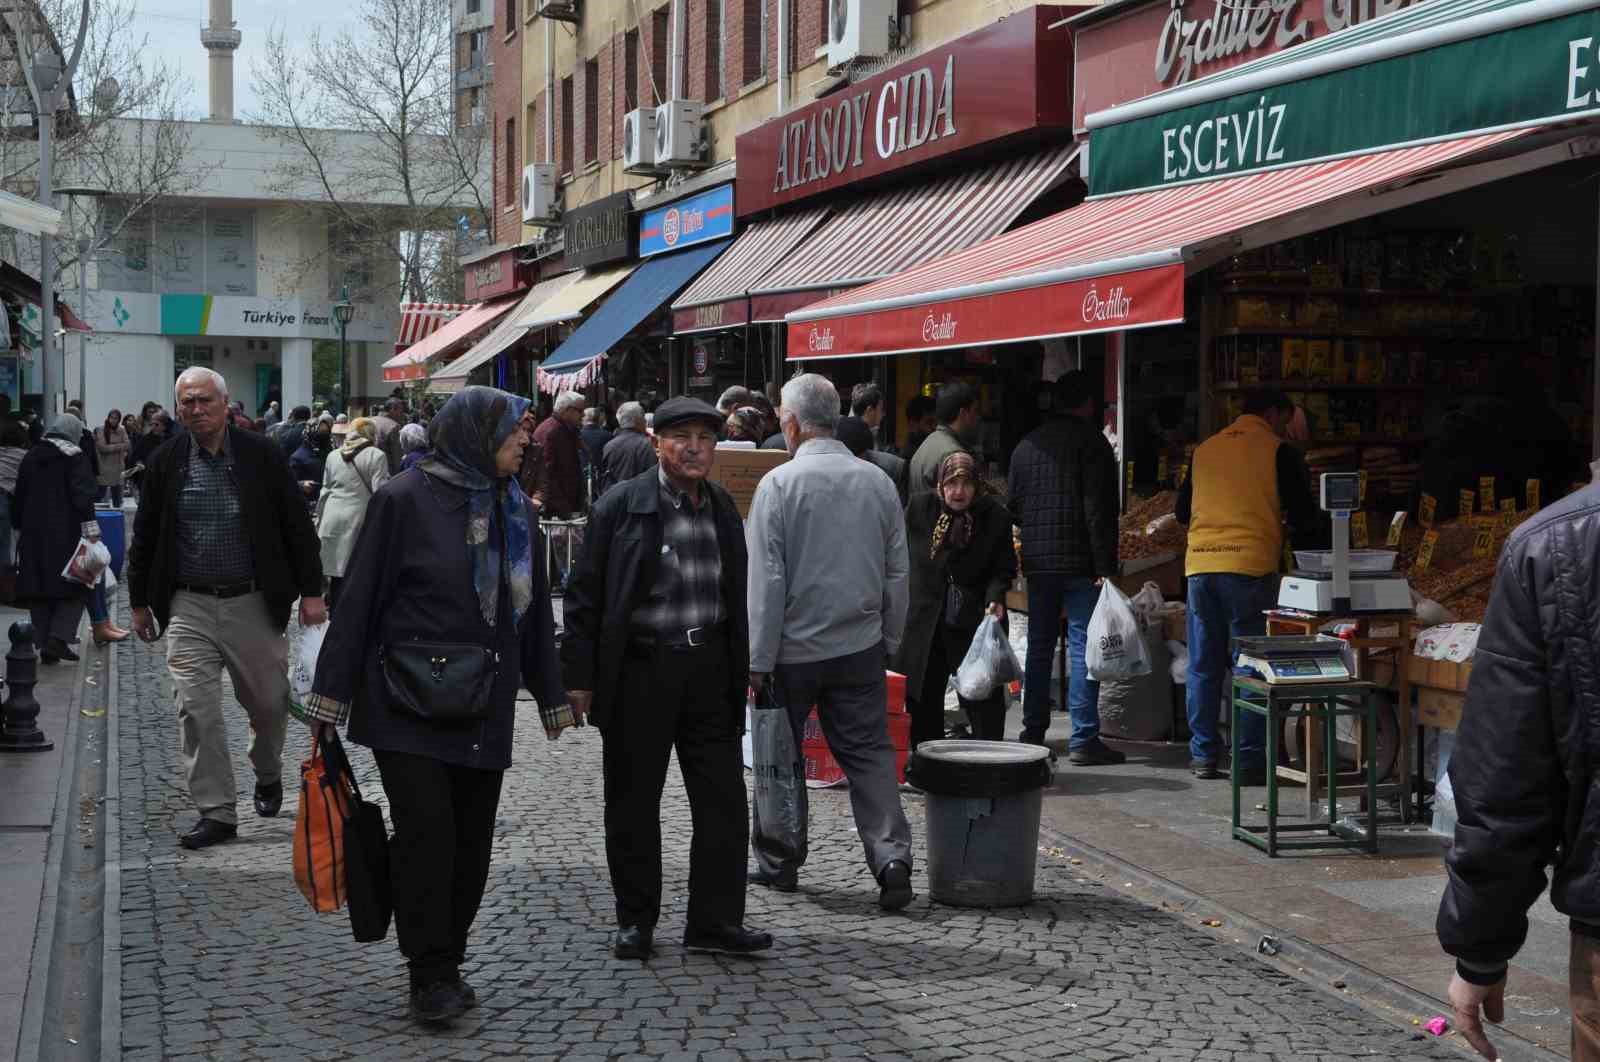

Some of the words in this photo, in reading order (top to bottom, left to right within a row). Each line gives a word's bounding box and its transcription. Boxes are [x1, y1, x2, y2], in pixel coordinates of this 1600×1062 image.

[1566, 37, 1600, 109] E
[773, 89, 872, 193] ATASOY
[875, 54, 957, 159] GIDA
[1162, 95, 1287, 181] ESCEVİZ
[243, 310, 296, 326] Türkiye
[1082, 283, 1132, 323] Özdiller
